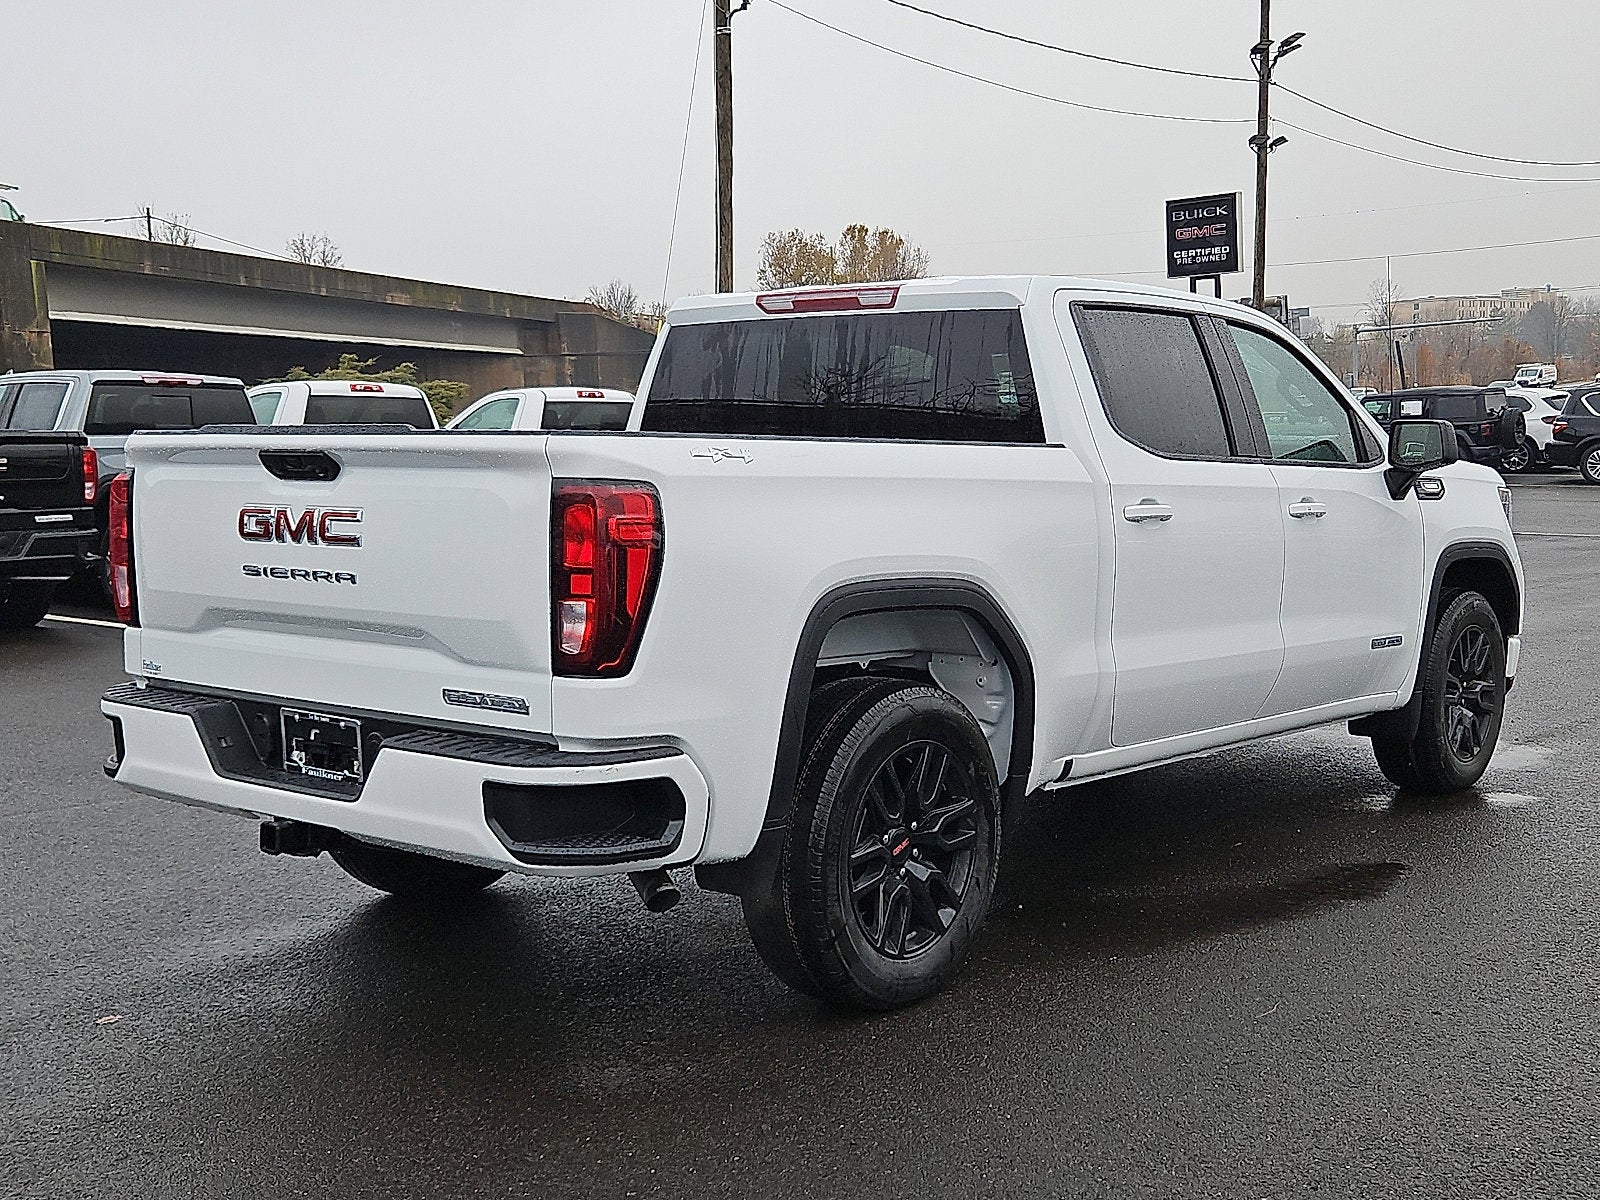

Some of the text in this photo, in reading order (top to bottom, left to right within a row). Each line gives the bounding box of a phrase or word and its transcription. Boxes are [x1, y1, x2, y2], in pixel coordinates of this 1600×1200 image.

[1172, 205, 1228, 221] BUICK
[1175, 223, 1227, 240] GMC
[1173, 246, 1230, 258] CERTIFIED
[1176, 254, 1227, 265] PRE-OWNED
[238, 503, 363, 548] GMC
[242, 564, 357, 585] SIERRA
[301, 766, 344, 781] Faulkner
